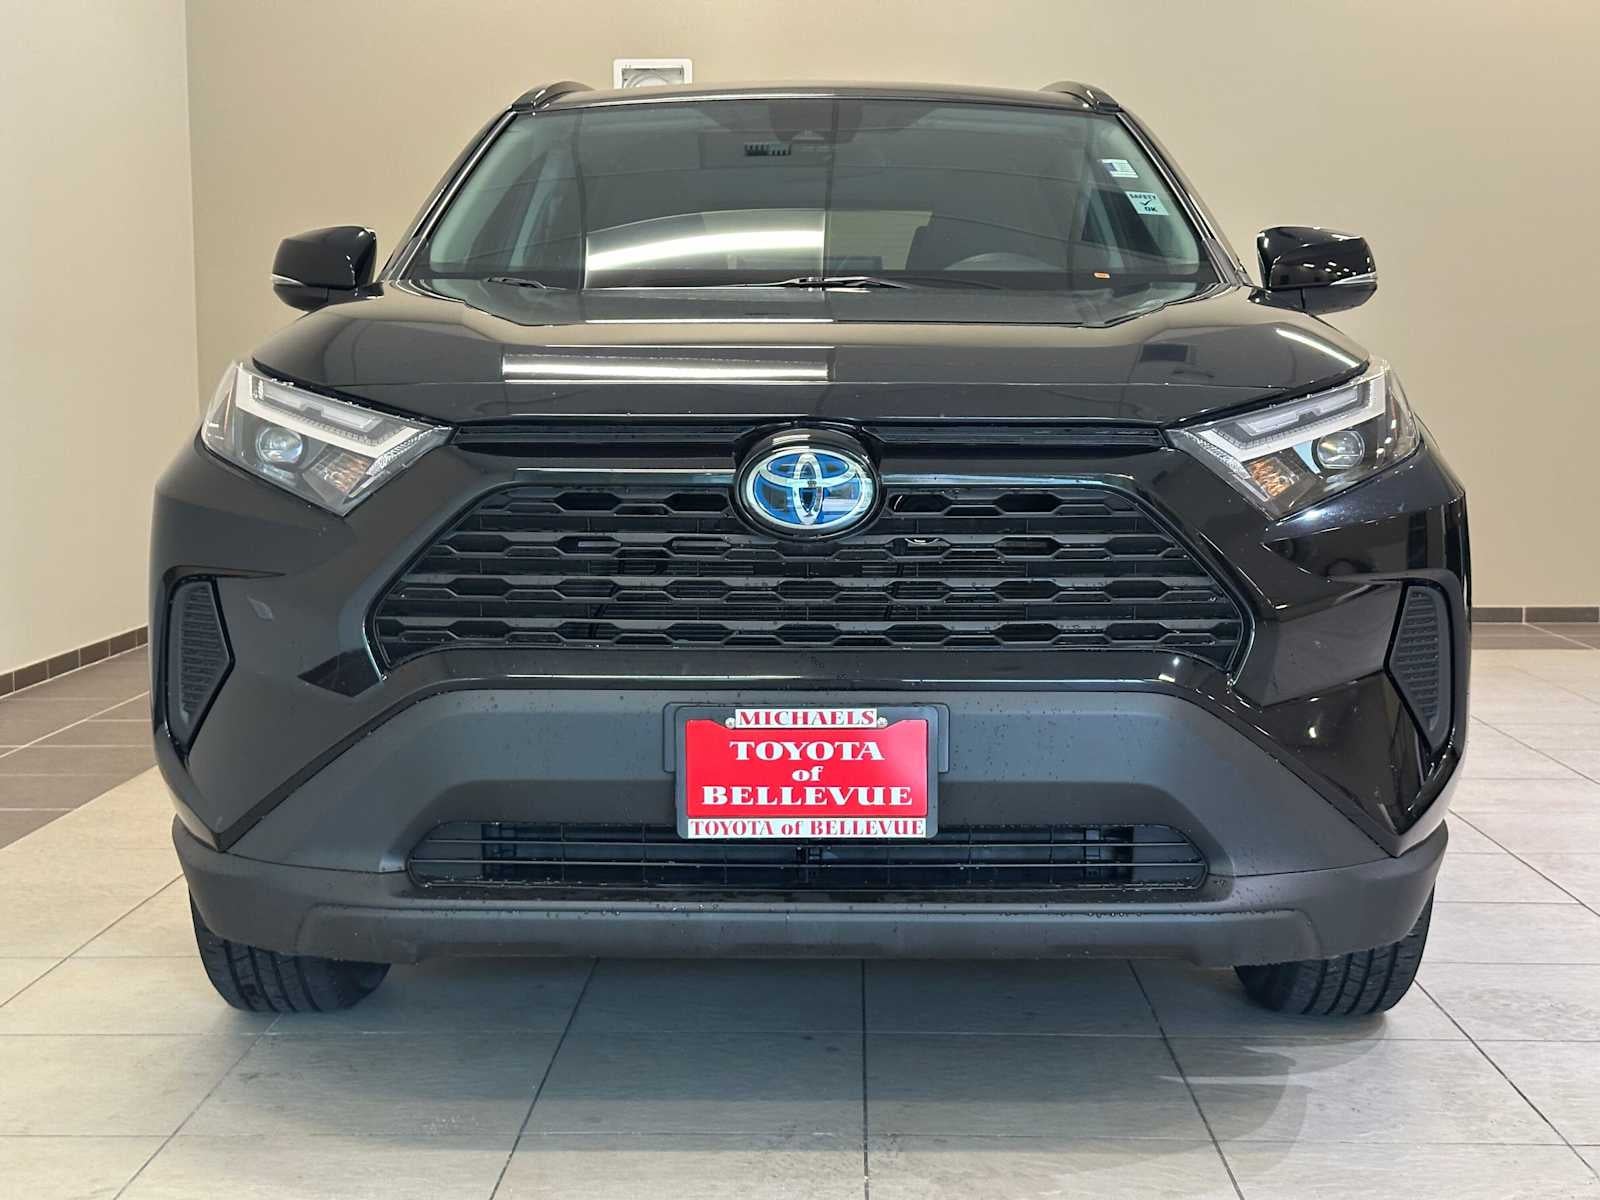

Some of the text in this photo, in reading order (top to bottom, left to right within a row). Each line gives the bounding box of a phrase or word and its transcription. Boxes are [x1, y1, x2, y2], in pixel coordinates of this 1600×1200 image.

[738, 710, 875, 726] MICHAELS
[729, 741, 885, 761] TOYOTA
[791, 765, 824, 782] of
[702, 786, 913, 806] BELLEVUE
[690, 820, 924, 836] TOYOTA of BELLEVUE
